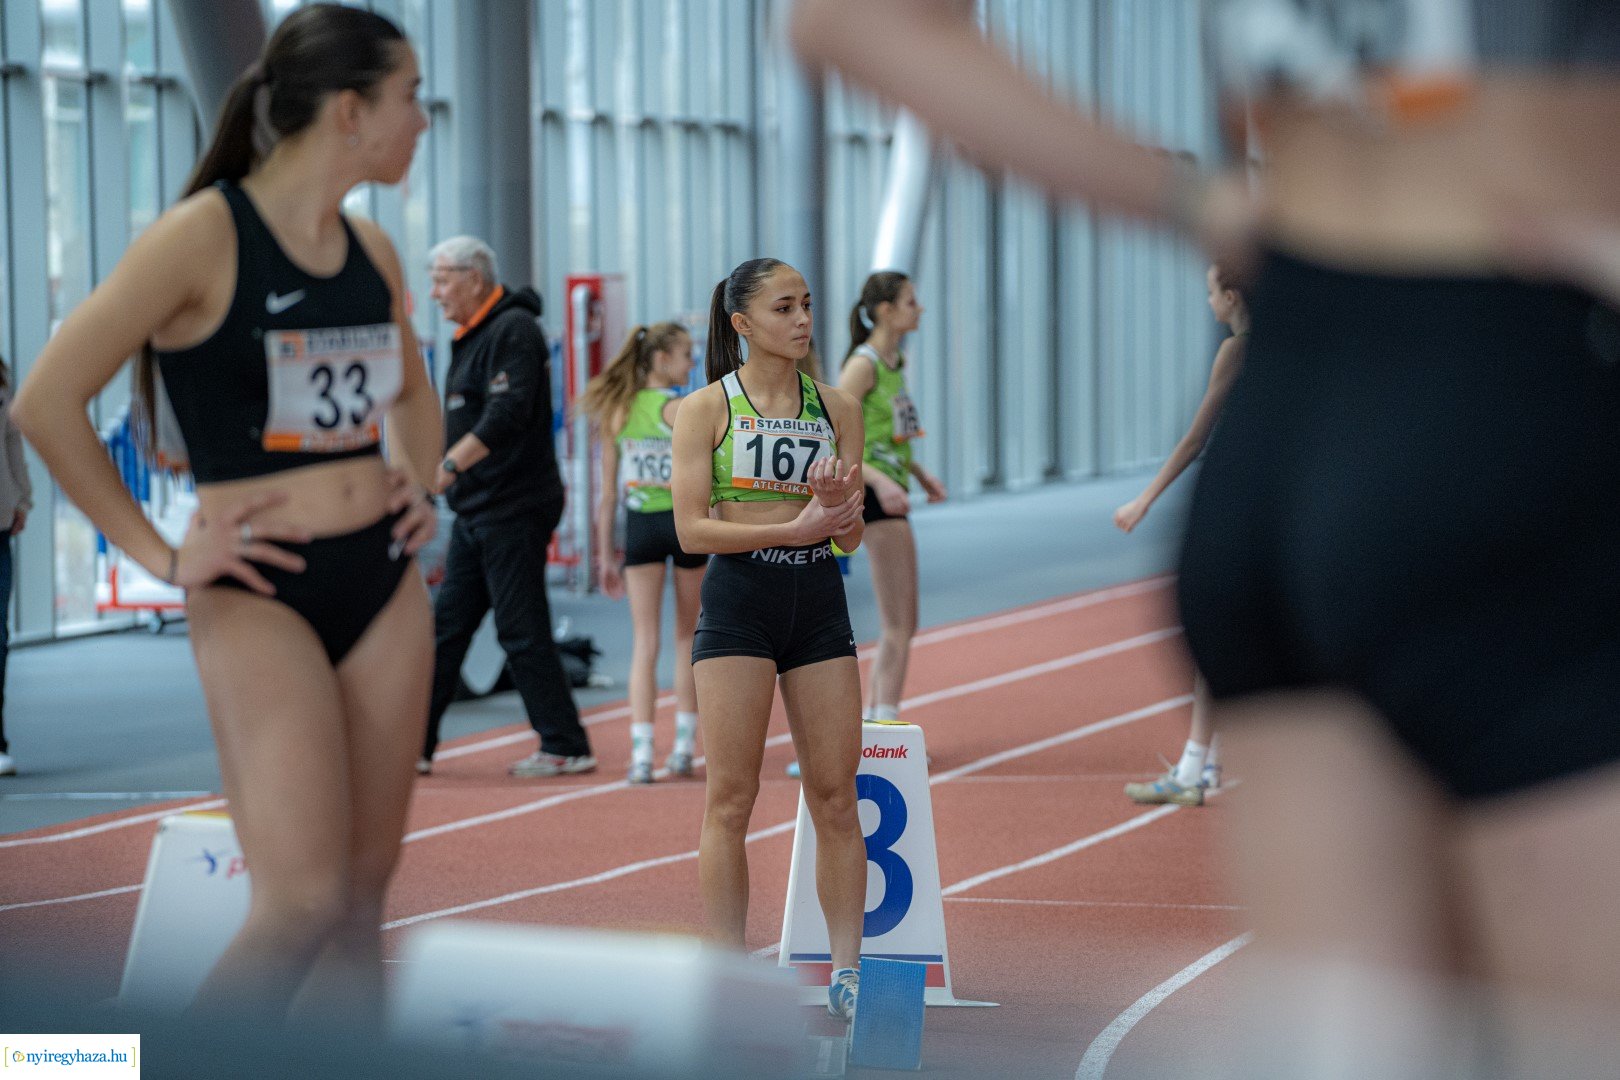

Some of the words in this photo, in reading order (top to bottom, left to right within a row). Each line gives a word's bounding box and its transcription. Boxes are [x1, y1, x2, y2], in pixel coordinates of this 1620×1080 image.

[310, 362, 374, 430] 33
[757, 419, 823, 434] STABILITA
[746, 433, 821, 484] 167
[752, 479, 809, 495] ATLETIKA
[750, 547, 809, 565] NIKE
[862, 743, 909, 759] olanik
